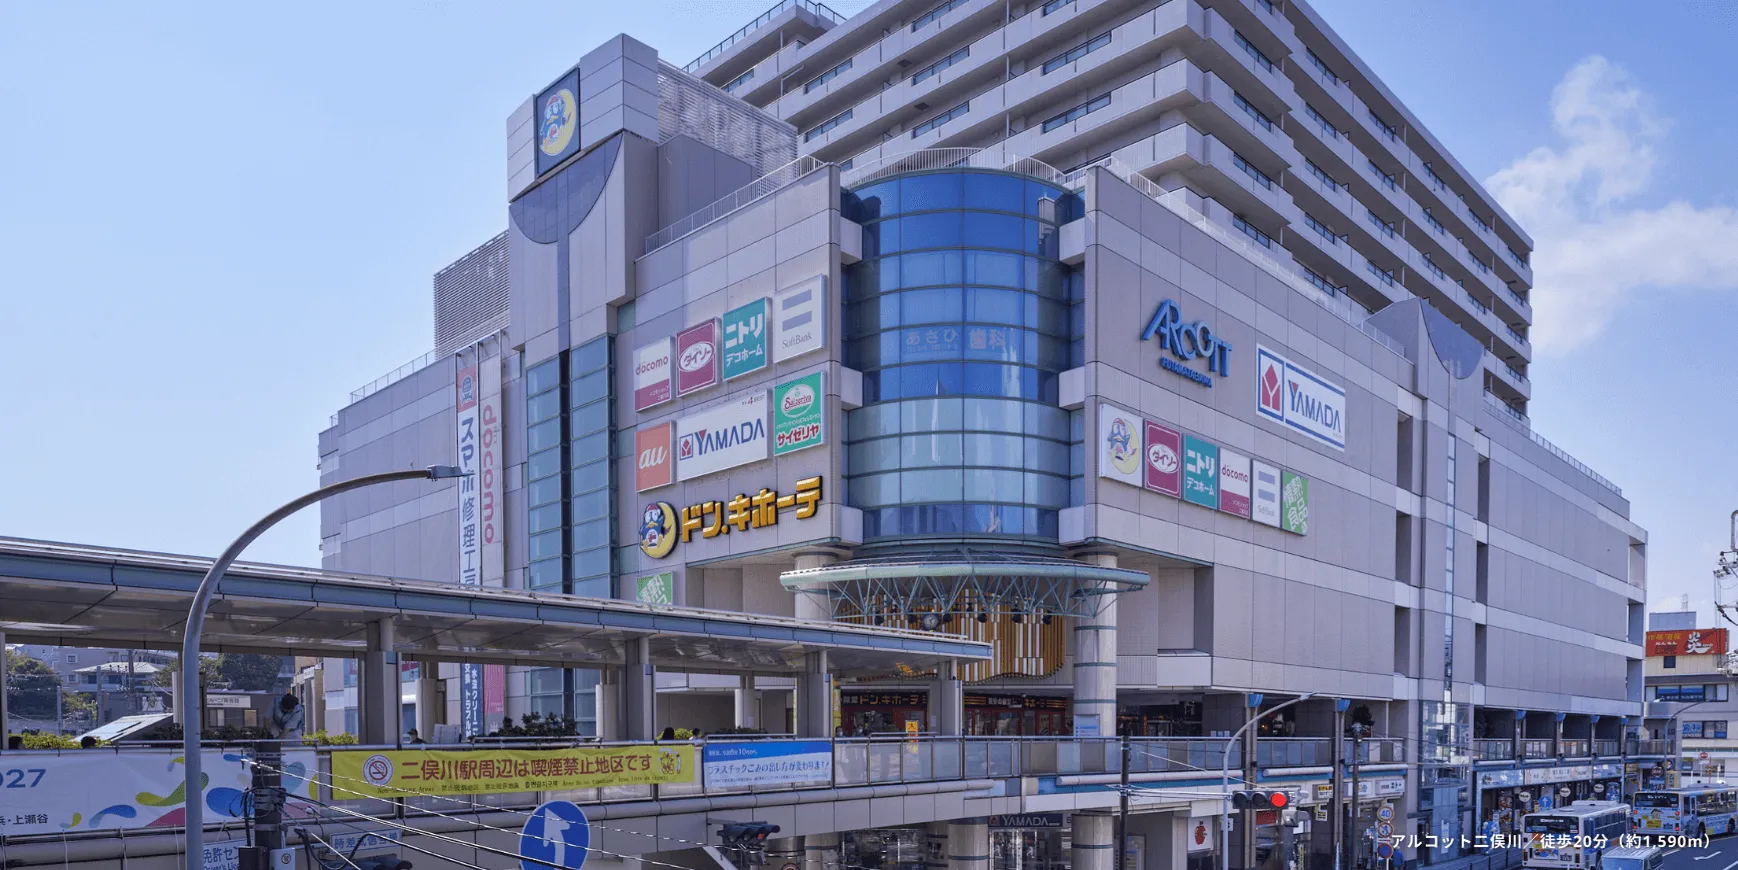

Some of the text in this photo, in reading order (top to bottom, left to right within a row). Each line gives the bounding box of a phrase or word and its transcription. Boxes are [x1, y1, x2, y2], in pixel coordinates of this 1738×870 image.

[725, 313, 763, 348] ニトリ
[782, 332, 812, 349] SoftBank
[906, 328, 958, 346] あさひ
[970, 328, 1005, 350] 歯科
[1141, 298, 1232, 377] ARCOTT
[635, 356, 669, 376] docomo
[683, 347, 711, 367] ダイソー
[726, 344, 763, 367] デコホーム
[1288, 379, 1341, 433] YAMADA
[695, 418, 765, 455] YAMADA
[777, 424, 820, 447] サイゼリヤ
[639, 445, 668, 470] au
[1152, 451, 1176, 467] ダイソー
[1187, 449, 1215, 478] ニトリ
[482, 404, 497, 544] docomo
[1222, 464, 1249, 483] docomo
[1187, 477, 1215, 496] デコホーム
[0, 769, 46, 788] 27
[401, 754, 653, 781] 二俣川駅周辺は喫煙禁止地区です
[1002, 815, 1049, 826] YAMADA
